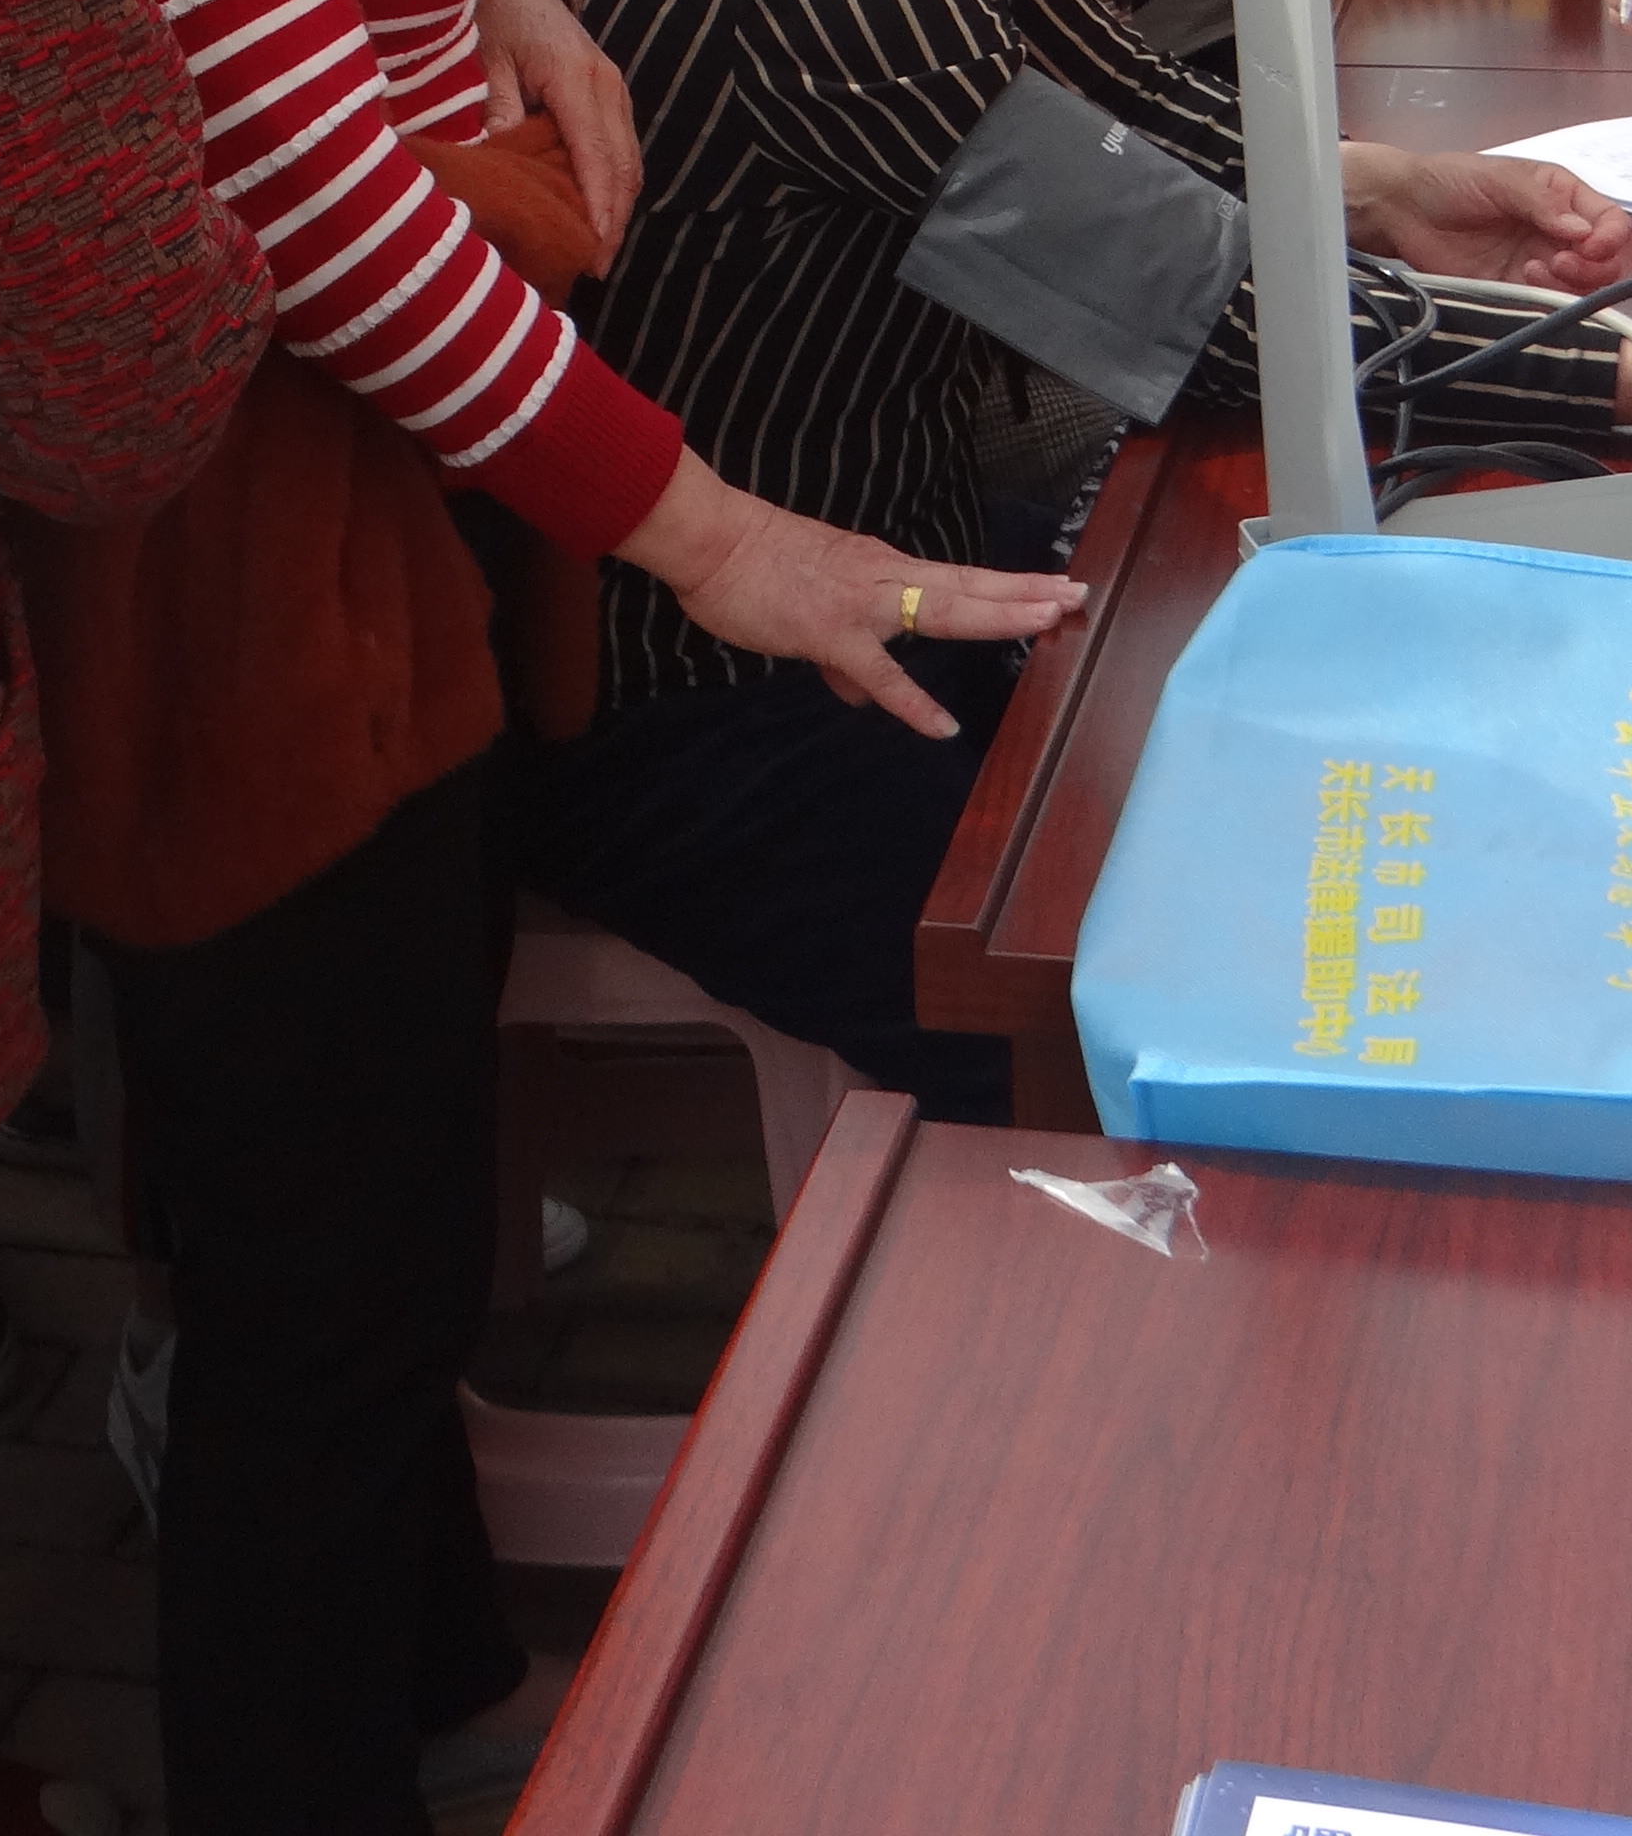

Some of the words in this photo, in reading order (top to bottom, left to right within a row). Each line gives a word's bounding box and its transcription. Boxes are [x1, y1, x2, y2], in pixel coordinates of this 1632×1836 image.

[1292, 758, 1373, 1057] 天长市法律援助中心
[1357, 764, 1436, 1065] 天长市司法局
